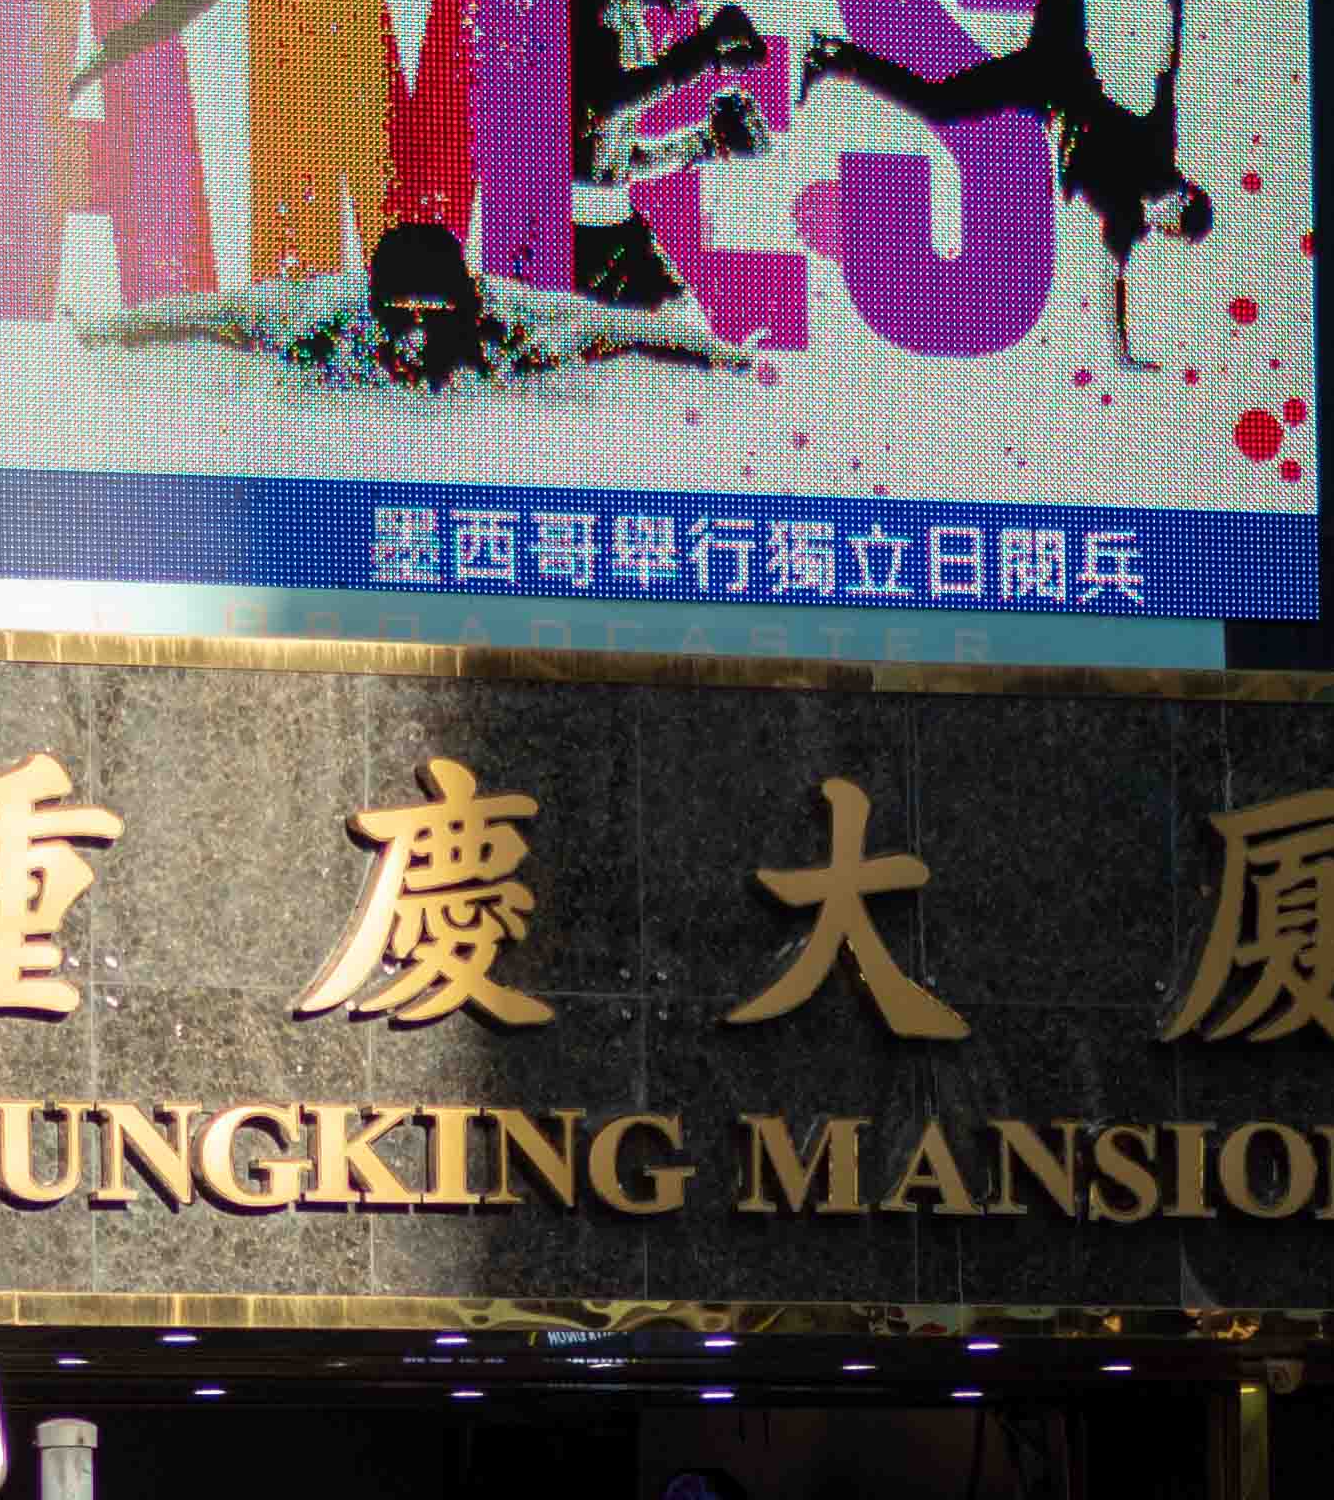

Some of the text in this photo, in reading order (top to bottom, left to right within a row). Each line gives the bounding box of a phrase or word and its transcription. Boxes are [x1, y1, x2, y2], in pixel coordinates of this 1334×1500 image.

[370, 505, 1145, 605] 墨西哥舉行獨立日閱兵
